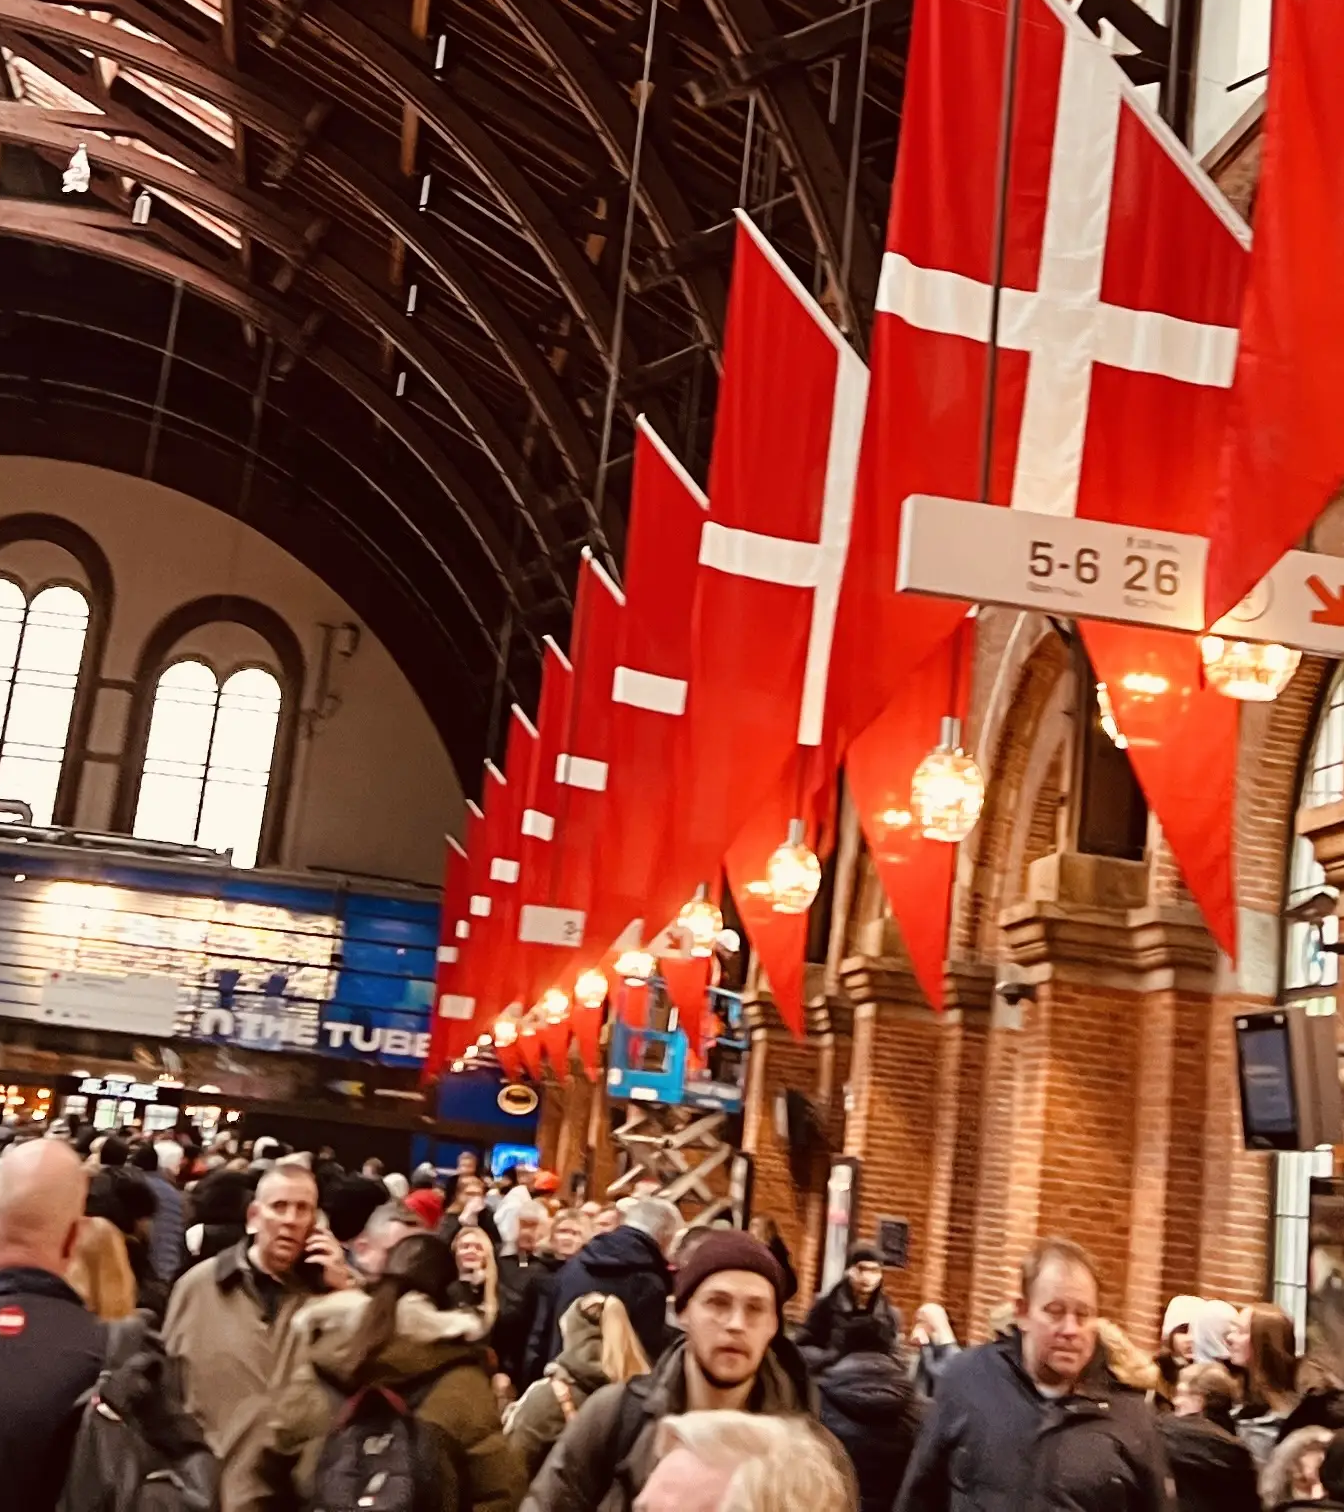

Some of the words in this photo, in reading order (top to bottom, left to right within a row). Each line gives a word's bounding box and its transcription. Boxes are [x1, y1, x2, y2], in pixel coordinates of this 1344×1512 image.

[1029, 541, 1099, 584] 5-6
[1124, 554, 1179, 596] 26
[322, 1021, 432, 1058] TUBE
